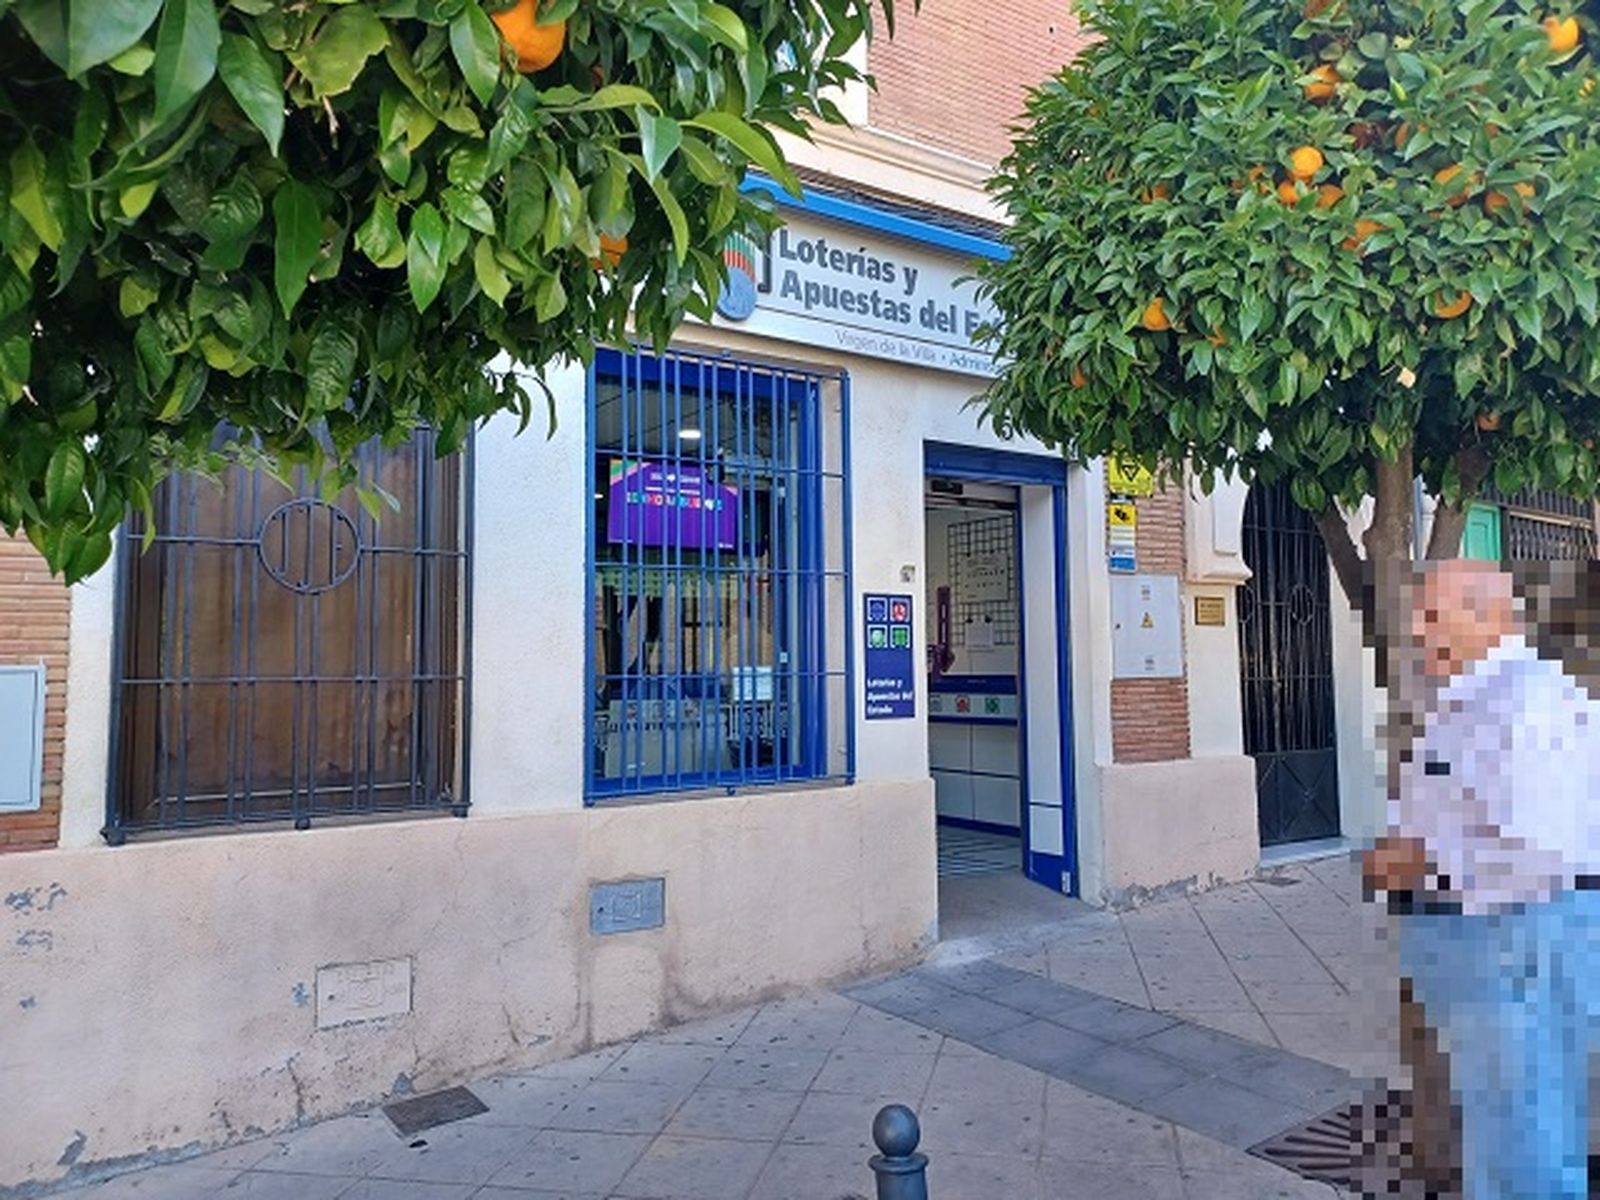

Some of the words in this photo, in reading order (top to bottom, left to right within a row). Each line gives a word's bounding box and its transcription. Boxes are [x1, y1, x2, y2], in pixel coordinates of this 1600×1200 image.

[779, 228, 896, 284] Loterías
[902, 266, 918, 296] y
[780, 269, 911, 325] Apuestas
[920, 299, 957, 334] del
